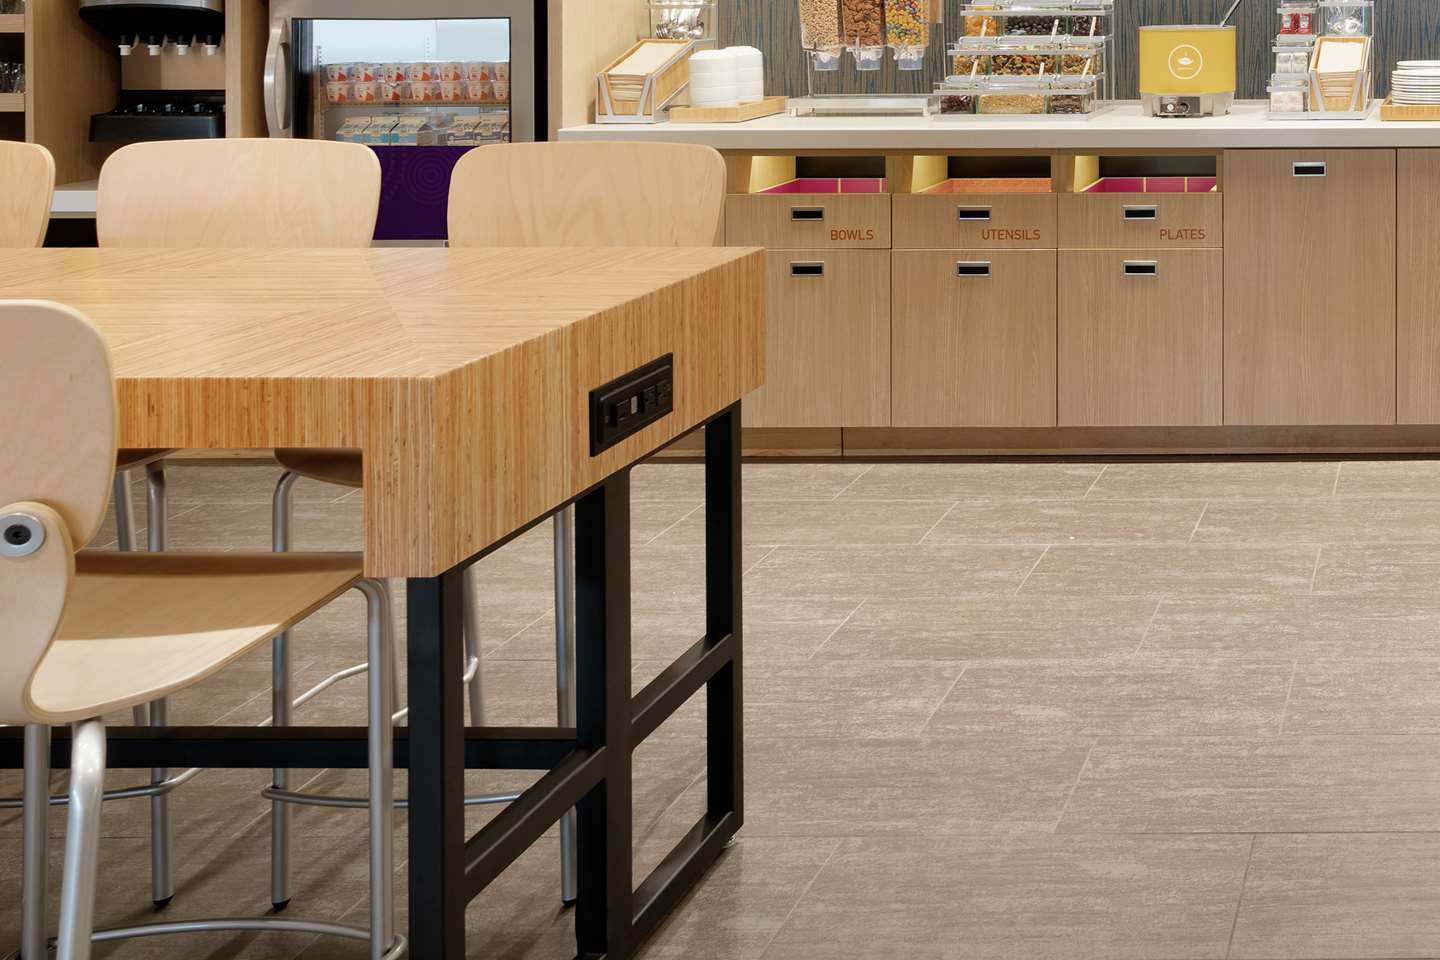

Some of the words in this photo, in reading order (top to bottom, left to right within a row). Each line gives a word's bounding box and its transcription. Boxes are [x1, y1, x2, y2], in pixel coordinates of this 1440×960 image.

[830, 229, 874, 241] BOWLS
[982, 229, 1041, 241] UTENSILS
[1159, 228, 1206, 240] PLATES
